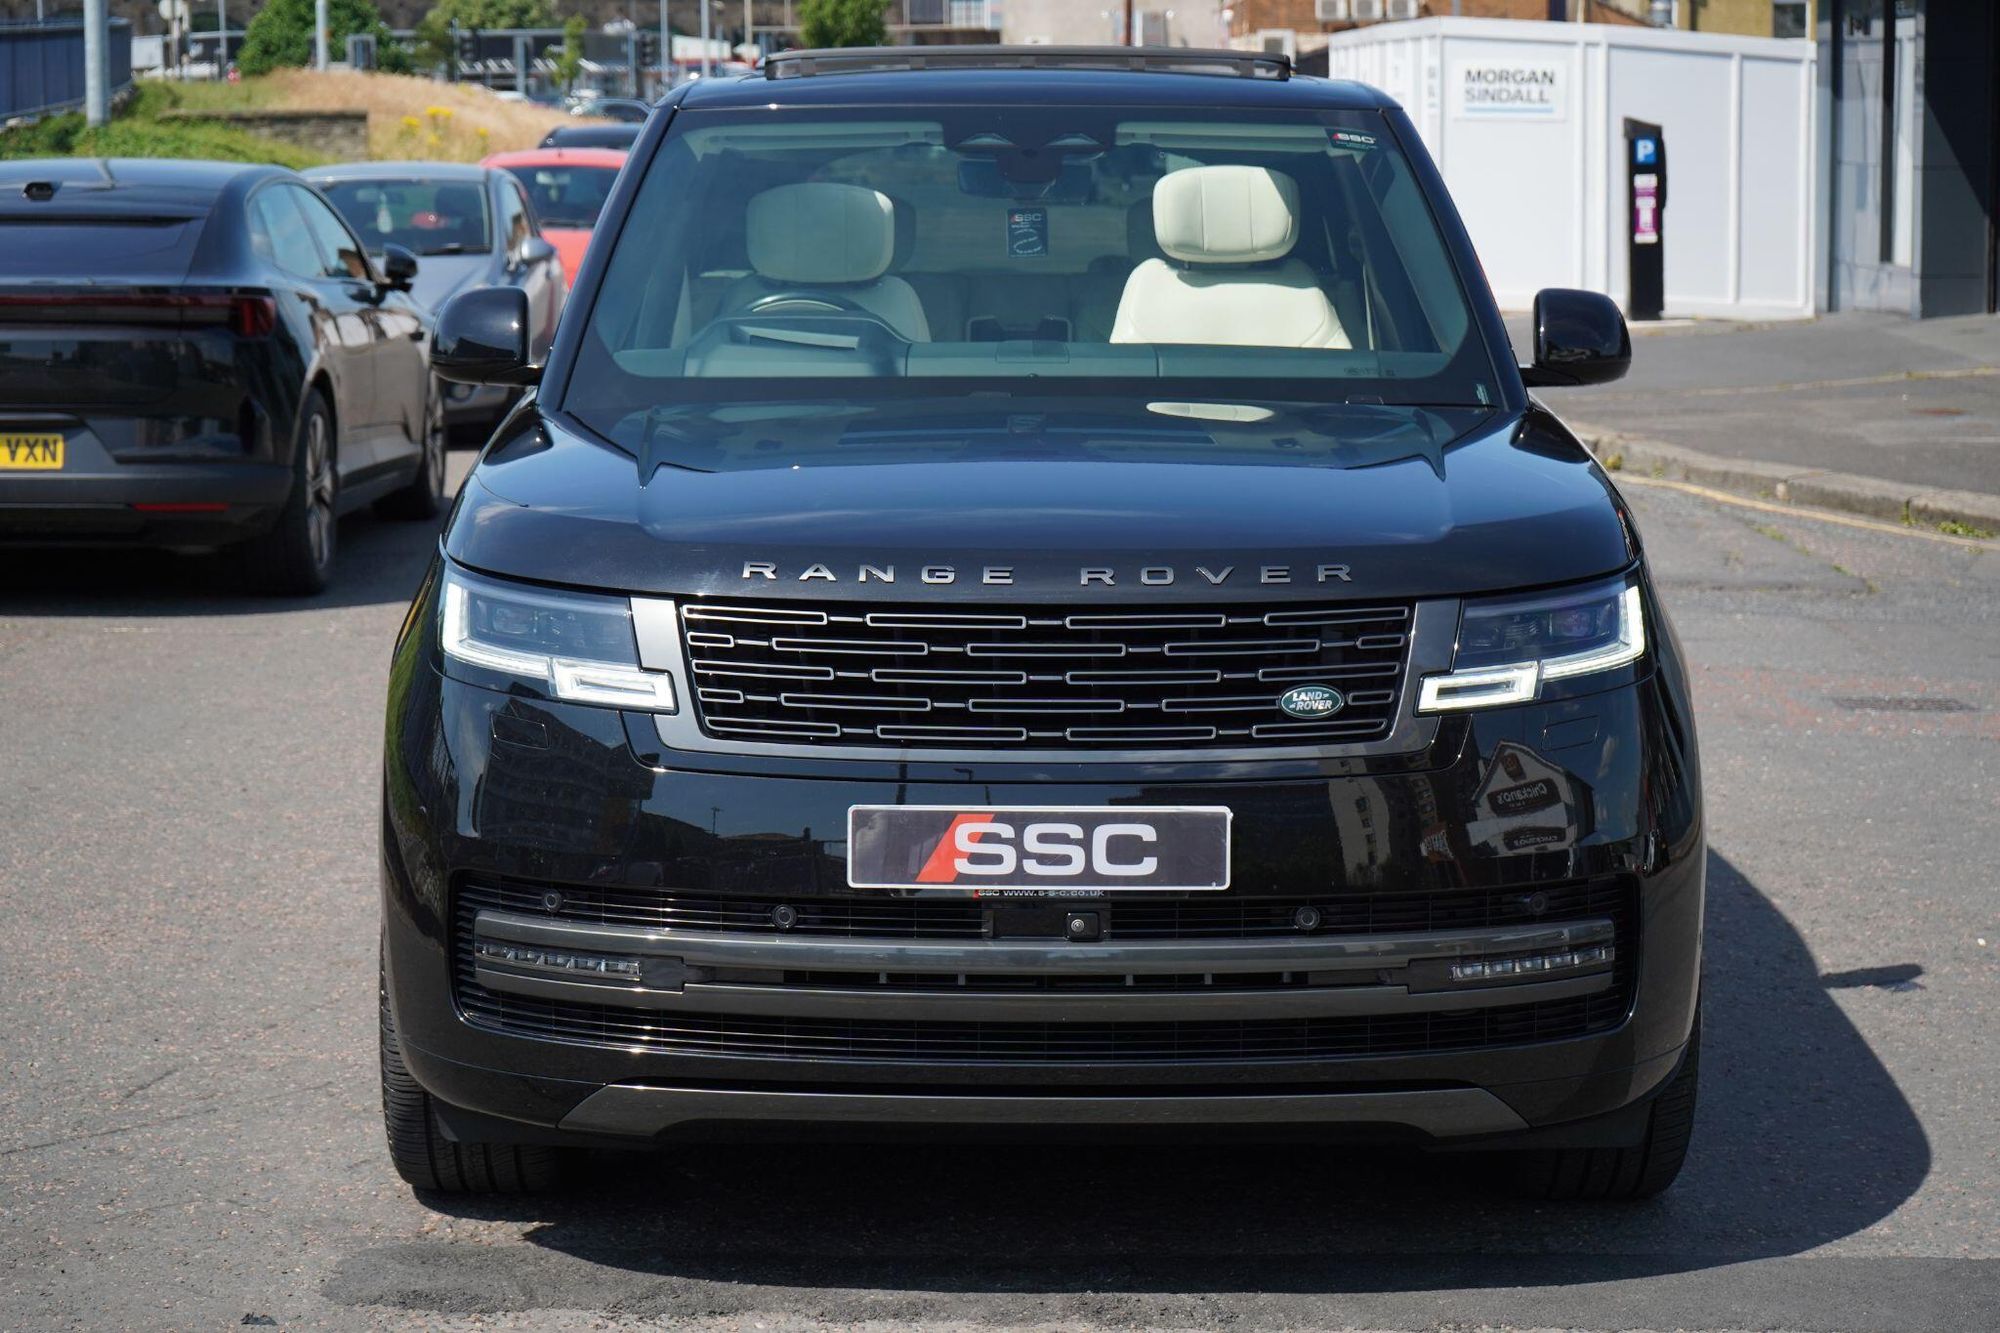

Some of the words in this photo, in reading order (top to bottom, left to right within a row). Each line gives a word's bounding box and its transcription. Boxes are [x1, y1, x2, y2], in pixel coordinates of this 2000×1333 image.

[1465, 69, 1555, 85] MORGAN
[1465, 87, 1550, 102] SINDALL
[1636, 139, 1655, 163] P
[6, 437, 58, 463] VXN
[742, 561, 1014, 585] RANGE
[1080, 563, 1353, 586] ROVER
[1292, 691, 1323, 702] LAND
[1295, 700, 1333, 711] ROVER
[953, 822, 1158, 876] SSC
